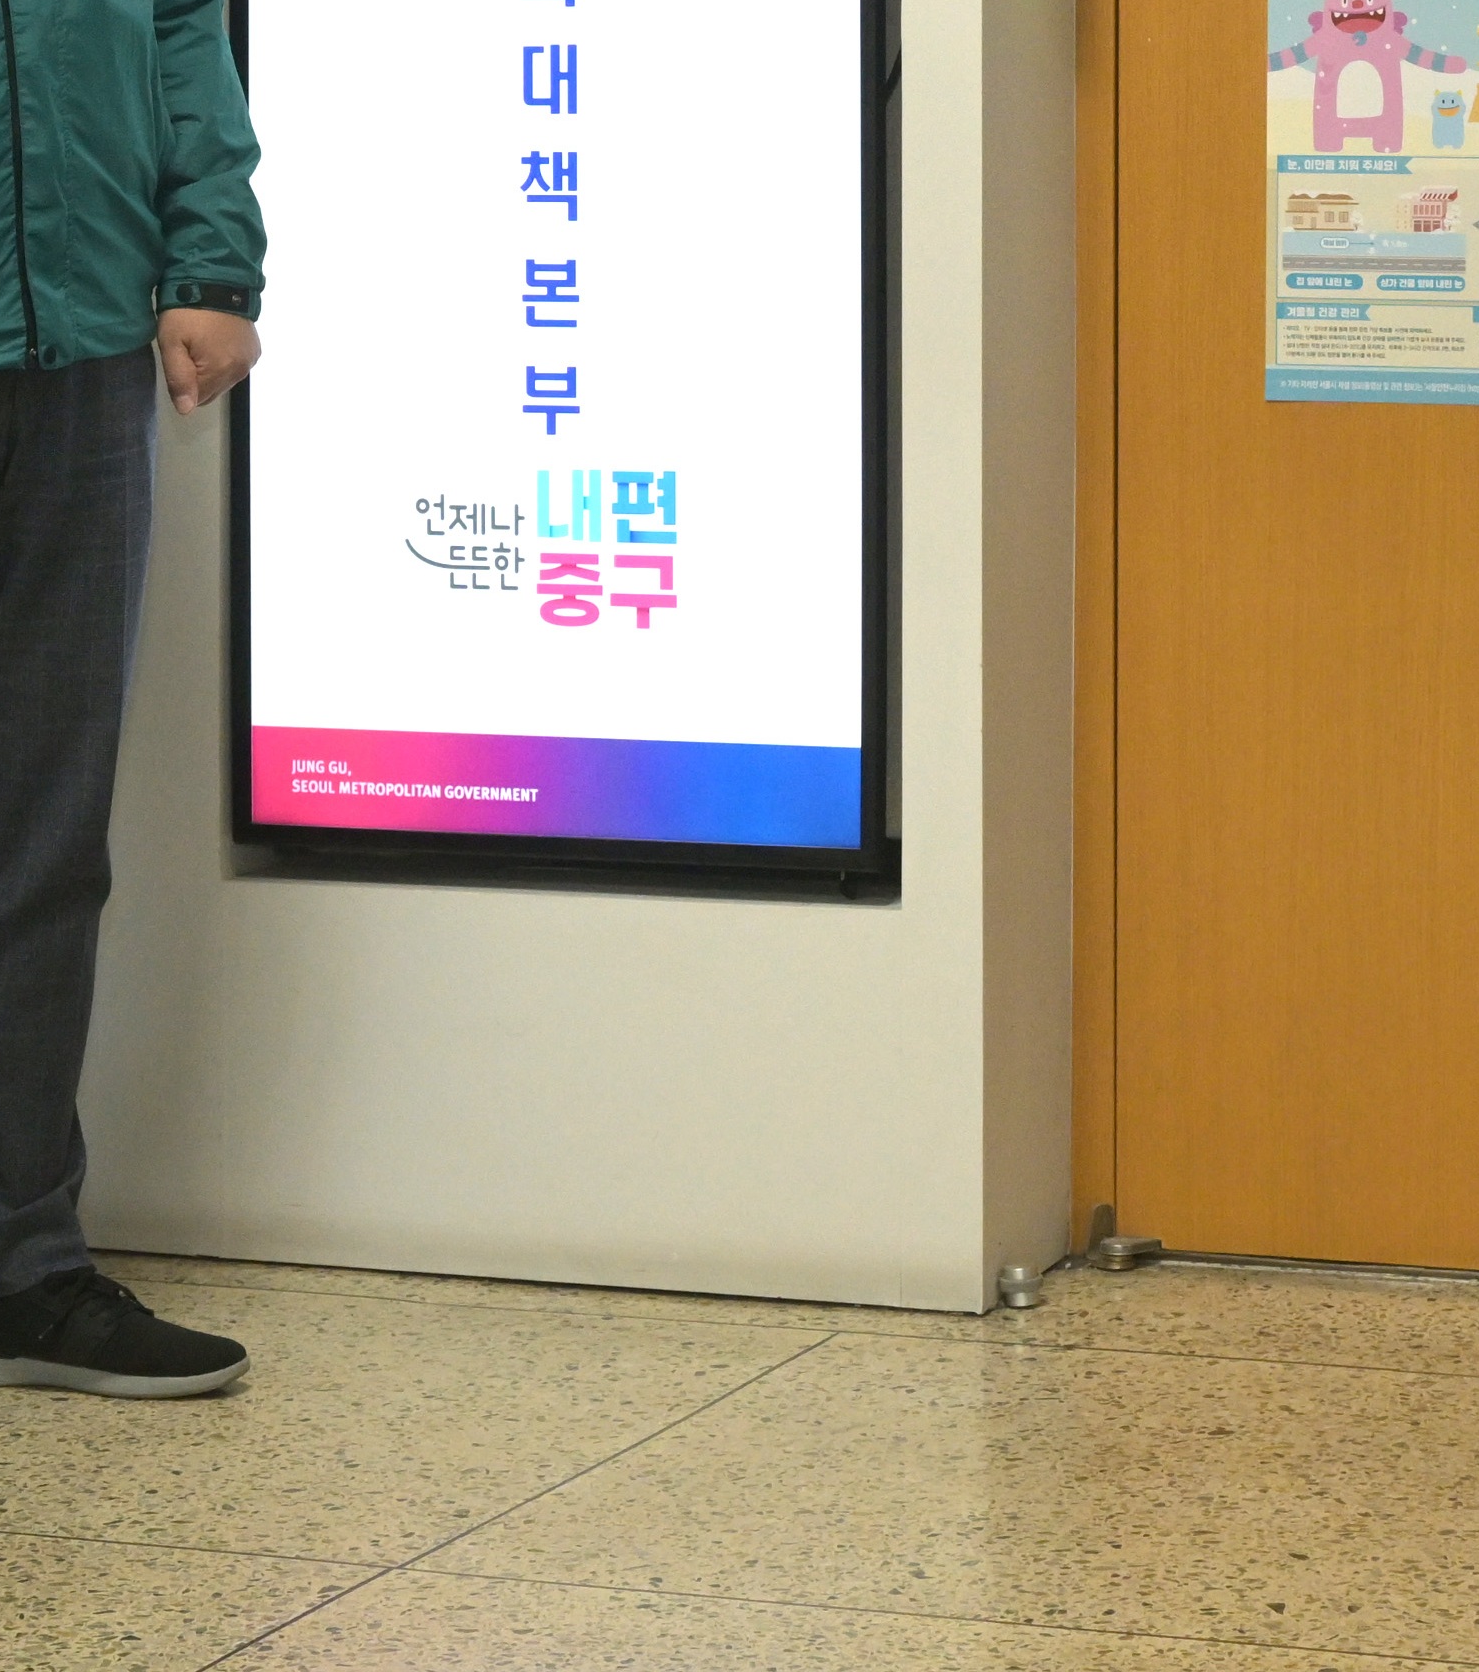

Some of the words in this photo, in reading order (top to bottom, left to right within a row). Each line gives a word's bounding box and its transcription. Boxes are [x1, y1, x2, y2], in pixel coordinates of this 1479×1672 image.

[1362, 160, 1398, 172] 주세요!
[415, 493, 525, 536] 언제나
[537, 469, 677, 544] 내편
[441, 541, 525, 590] 든든한
[537, 552, 677, 629] 중구
[292, 760, 325, 775] JUNG
[328, 761, 352, 777] GU,
[292, 779, 335, 796] SEOUL
[339, 781, 441, 799] METROPOLITAN
[444, 785, 538, 802] GOVERNMENT
